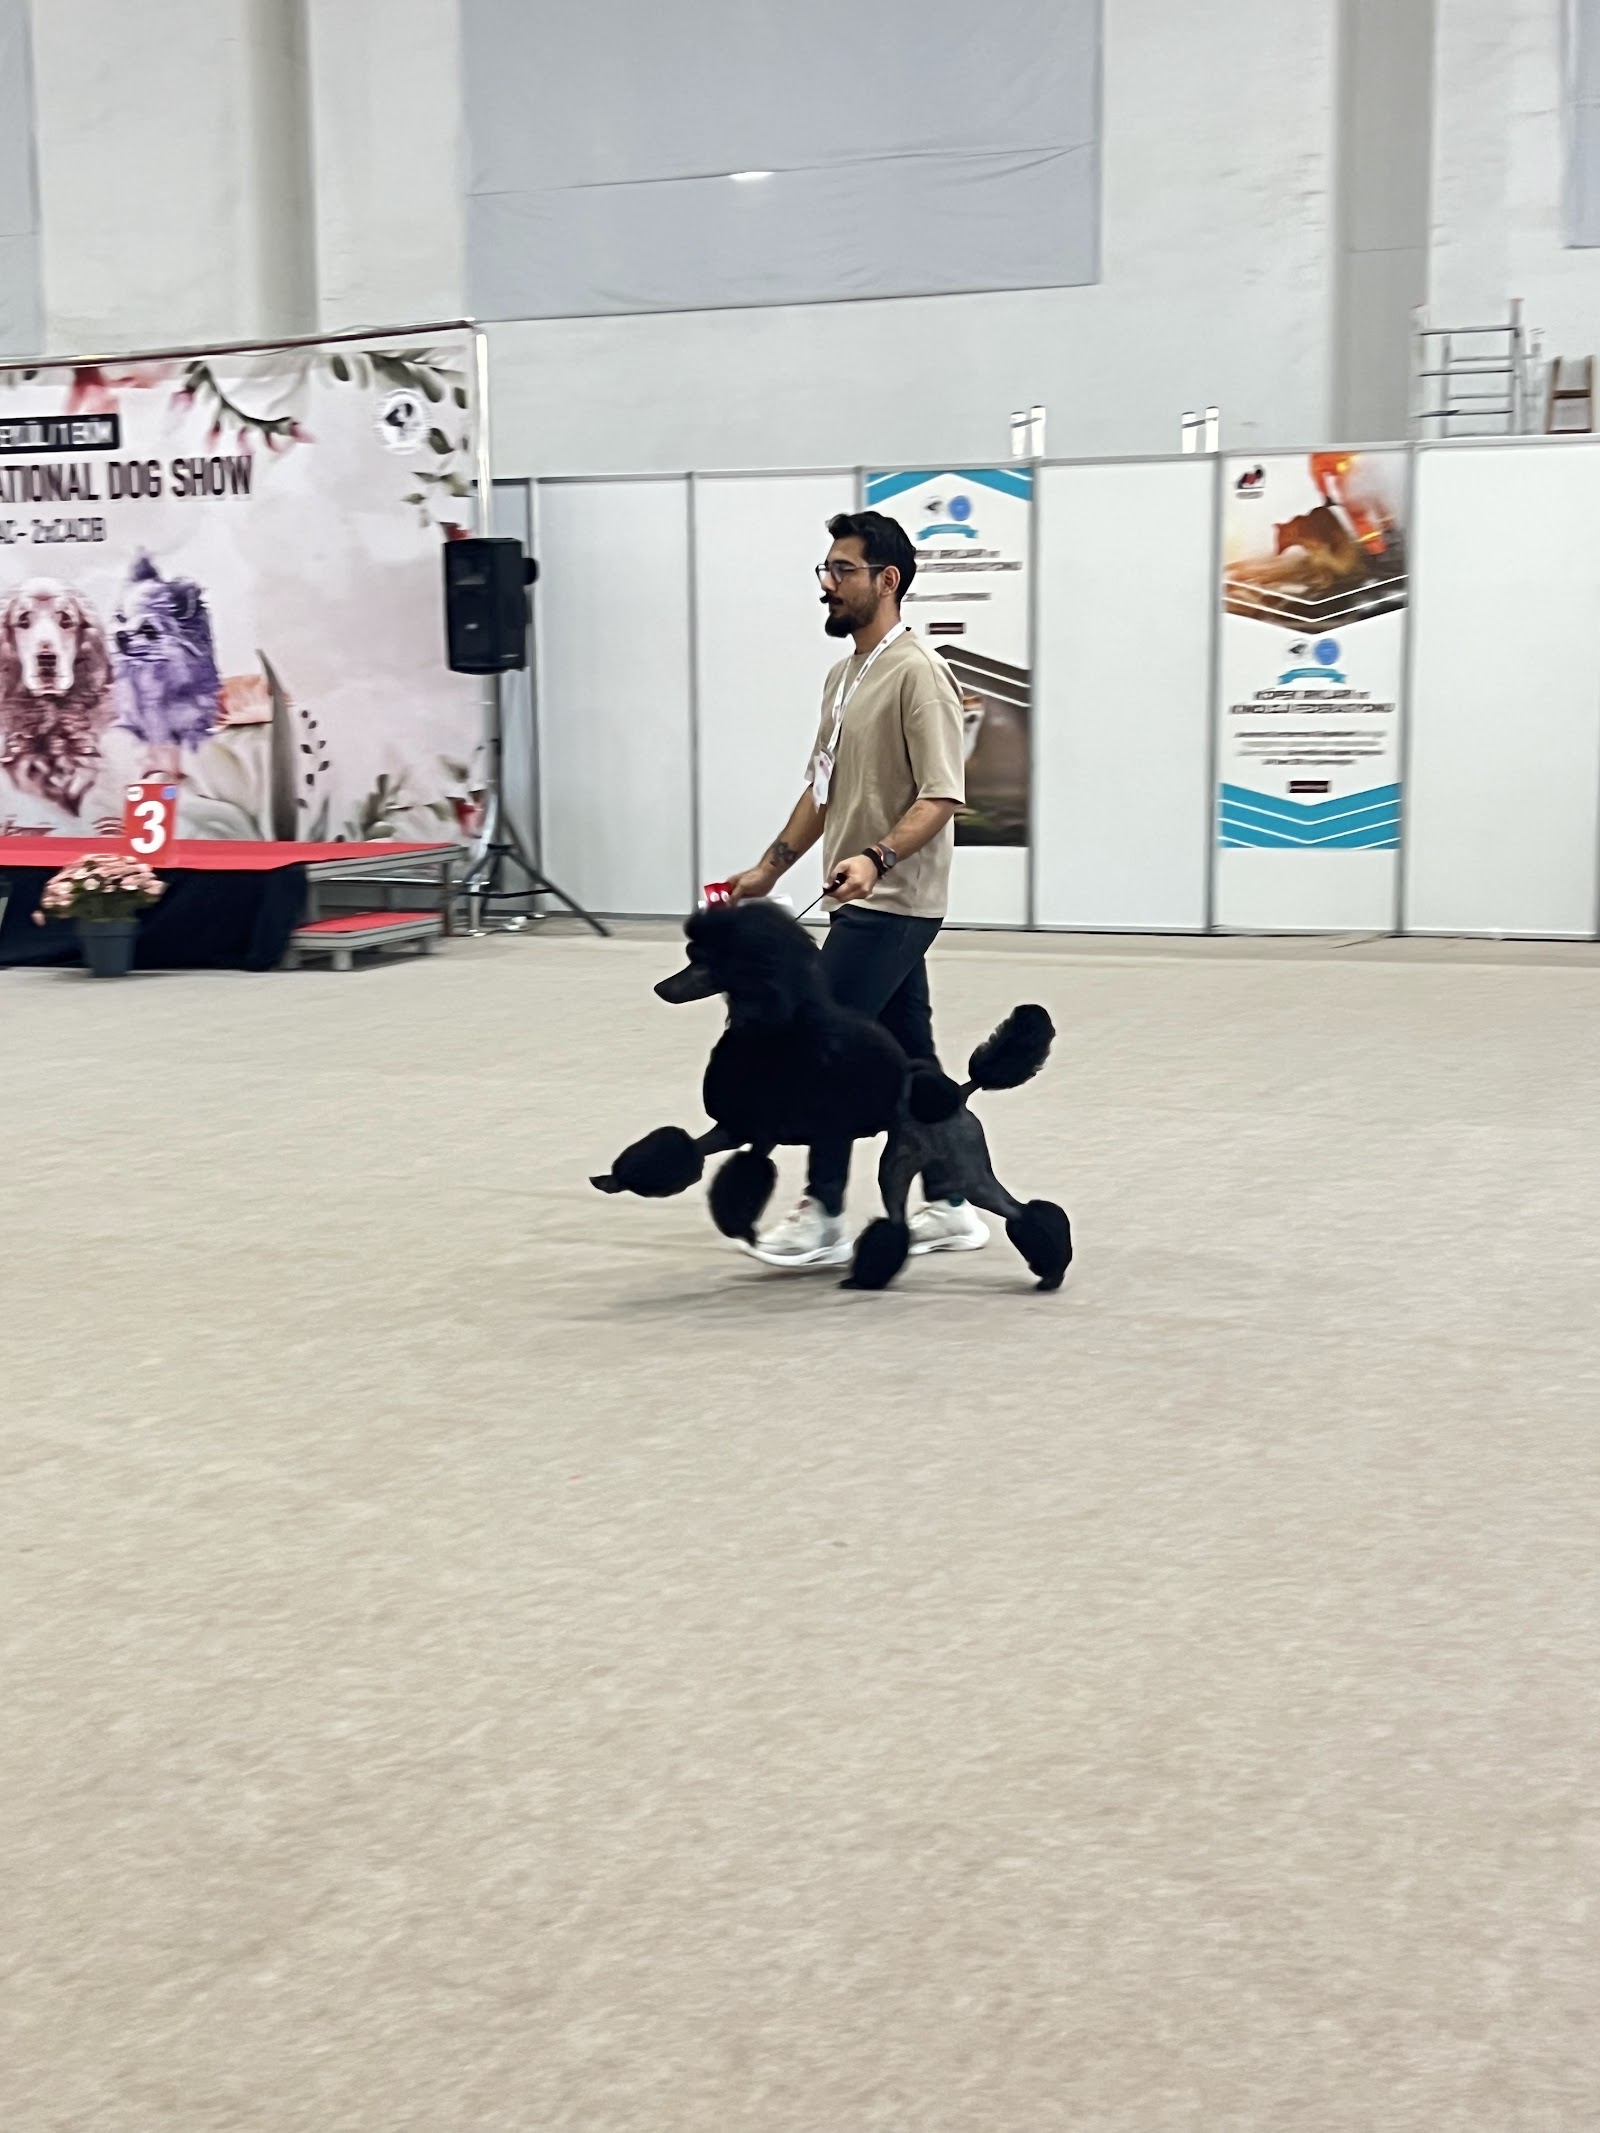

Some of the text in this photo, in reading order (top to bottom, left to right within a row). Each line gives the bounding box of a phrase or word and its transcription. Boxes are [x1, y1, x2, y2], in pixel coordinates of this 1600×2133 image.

[107, 459, 162, 500] DOG
[171, 455, 252, 498] SHOW
[130, 800, 166, 854] 3
